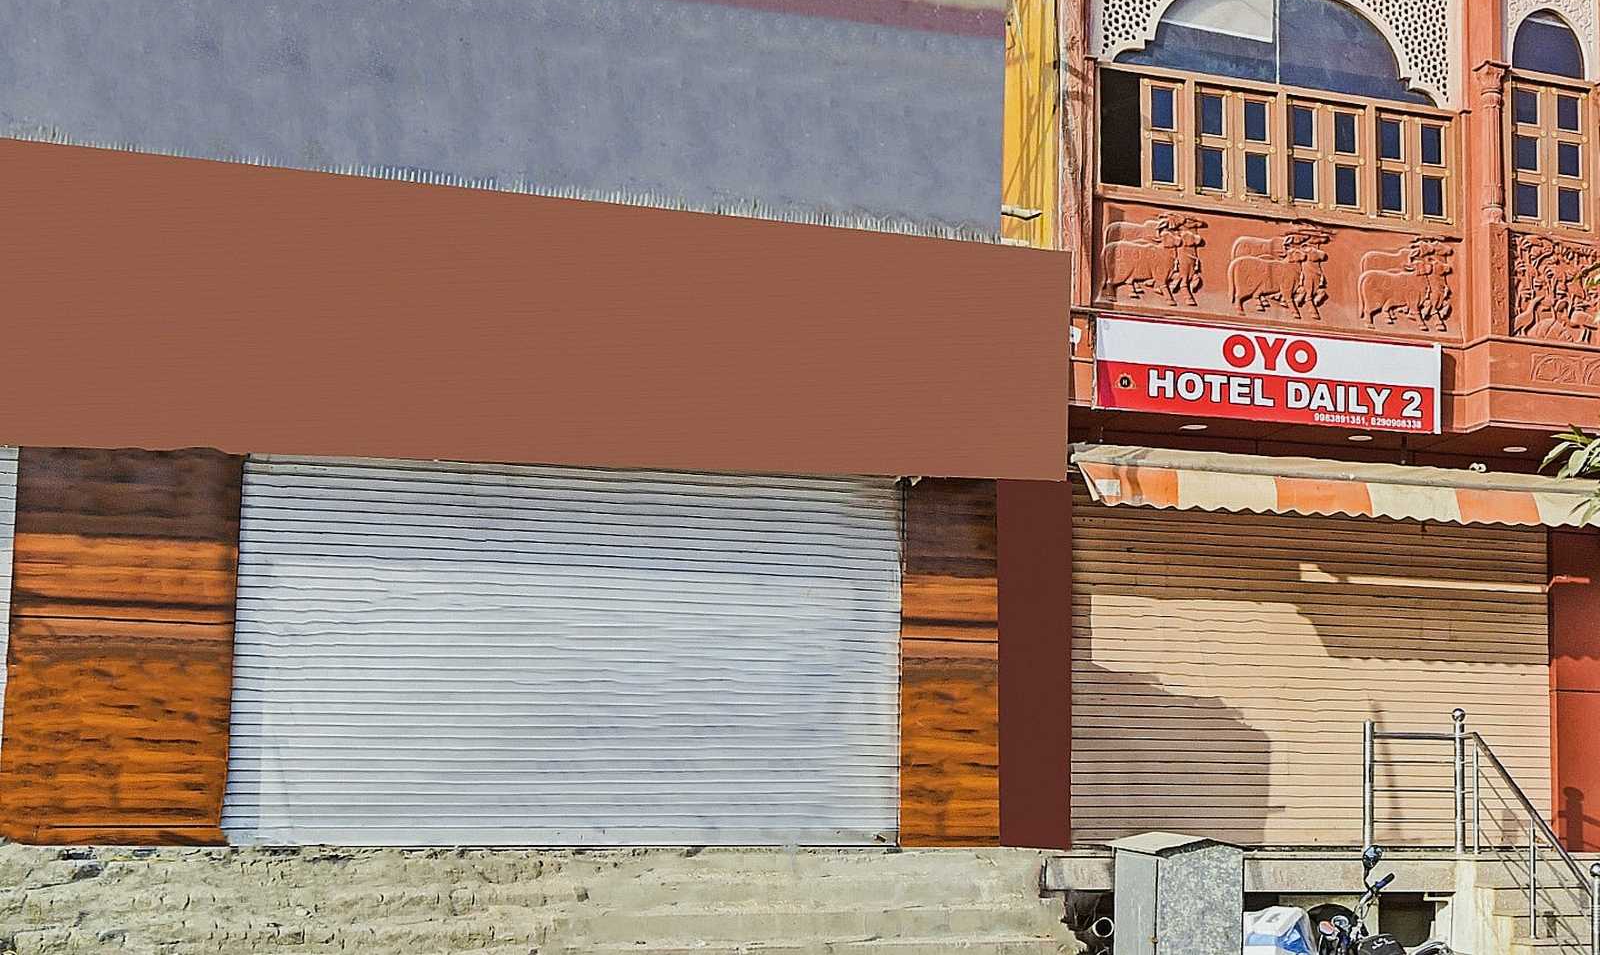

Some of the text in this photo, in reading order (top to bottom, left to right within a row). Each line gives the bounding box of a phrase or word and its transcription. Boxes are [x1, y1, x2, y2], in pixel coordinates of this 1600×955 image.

[1223, 334, 1317, 373] OYO
[1148, 369, 1423, 418] HOTEL DAILY 2
